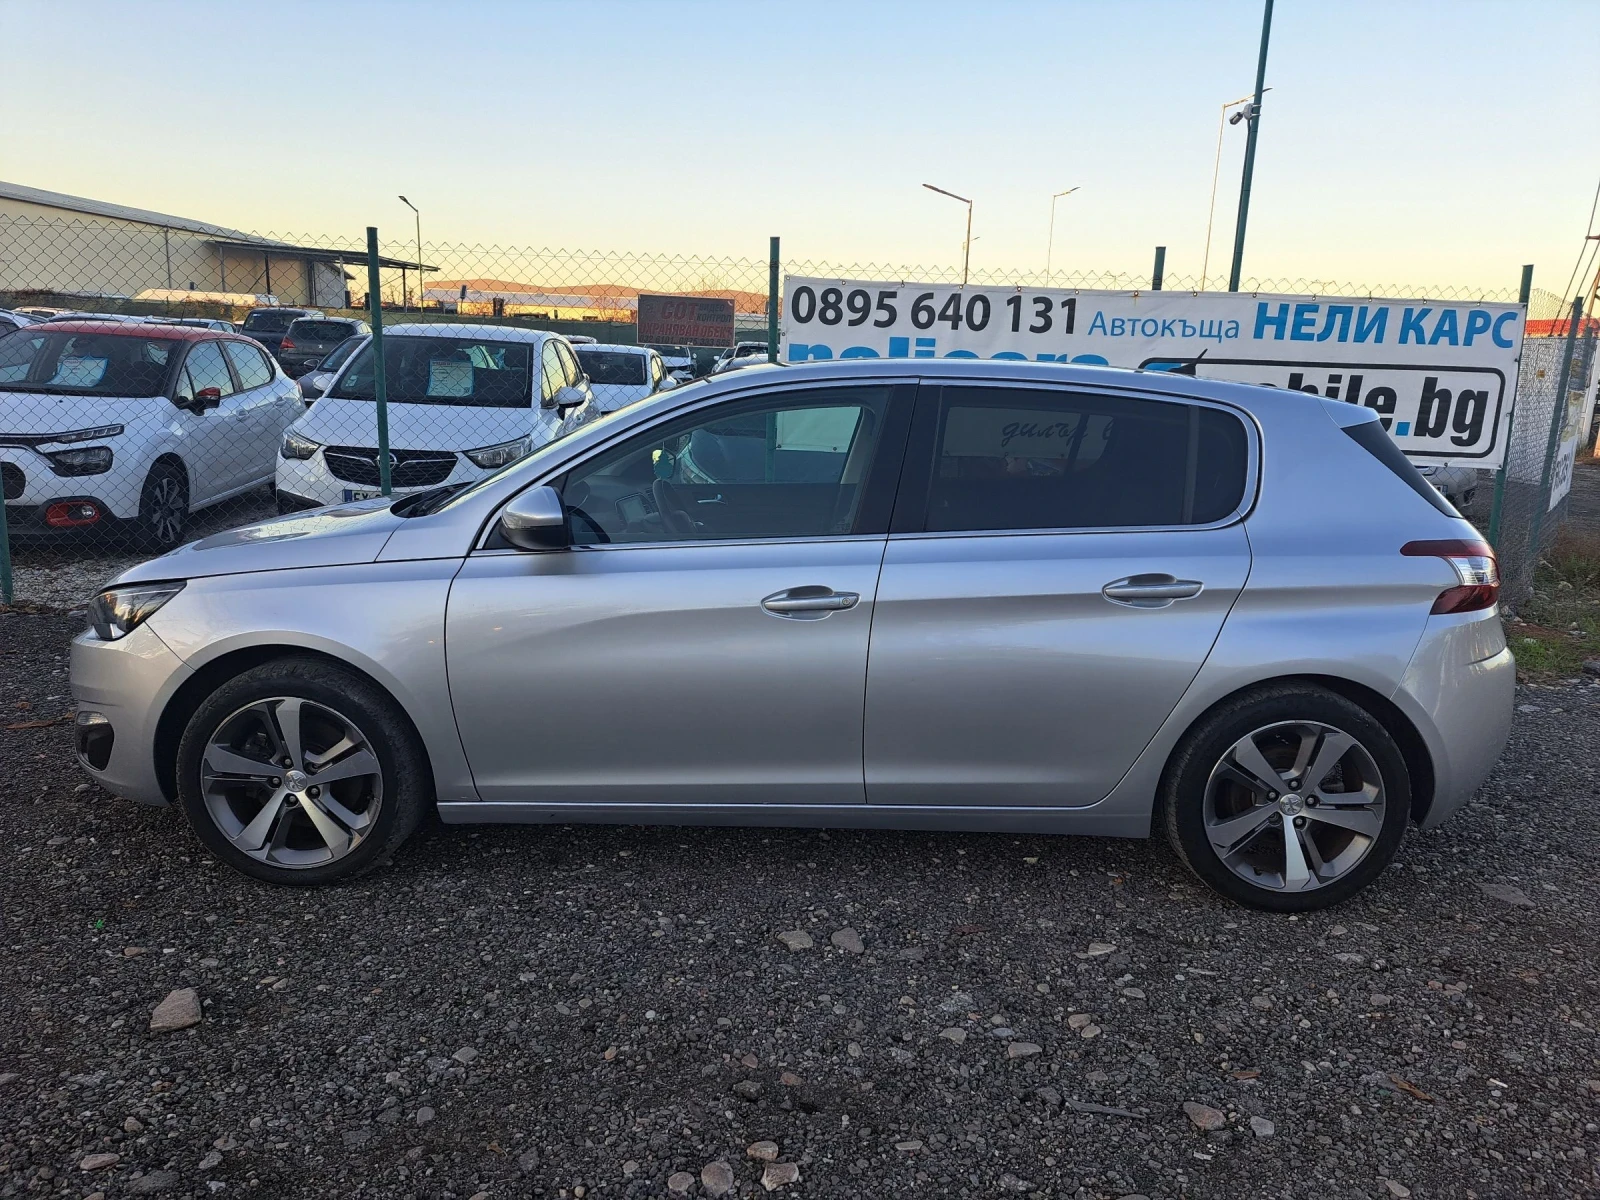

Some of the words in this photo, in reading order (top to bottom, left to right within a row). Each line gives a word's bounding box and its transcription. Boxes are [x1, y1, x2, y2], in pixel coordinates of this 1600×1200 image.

[662, 300, 698, 320] СОТ
[791, 285, 898, 328] 0895
[910, 292, 991, 332] 640
[1006, 295, 1077, 335] 131
[1087, 310, 1240, 343] Автокъща
[1253, 302, 1389, 344] НЕЛИ
[1398, 307, 1519, 349] КАРС
